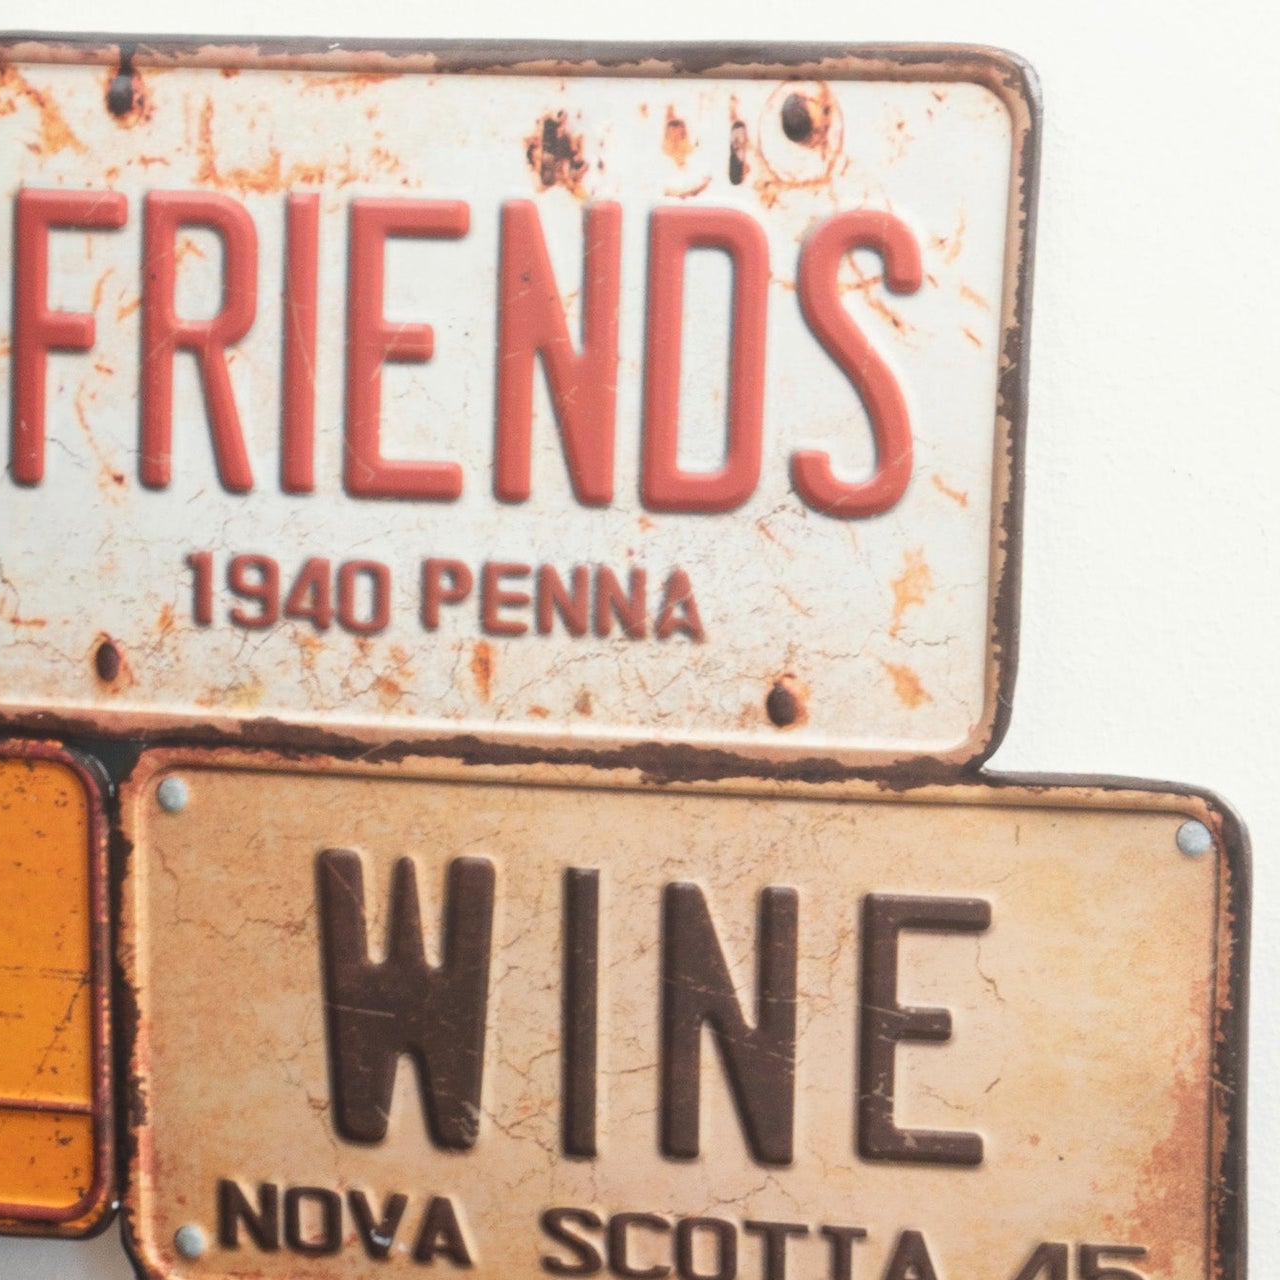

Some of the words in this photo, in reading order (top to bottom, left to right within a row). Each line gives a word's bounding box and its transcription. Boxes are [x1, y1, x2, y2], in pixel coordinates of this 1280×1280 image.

[11, 187, 924, 520] FRIENDS
[188, 550, 391, 637] 1940
[420, 556, 706, 645] PENNA
[317, 847, 993, 1170] WINE
[216, 1177, 474, 1269] NOVA
